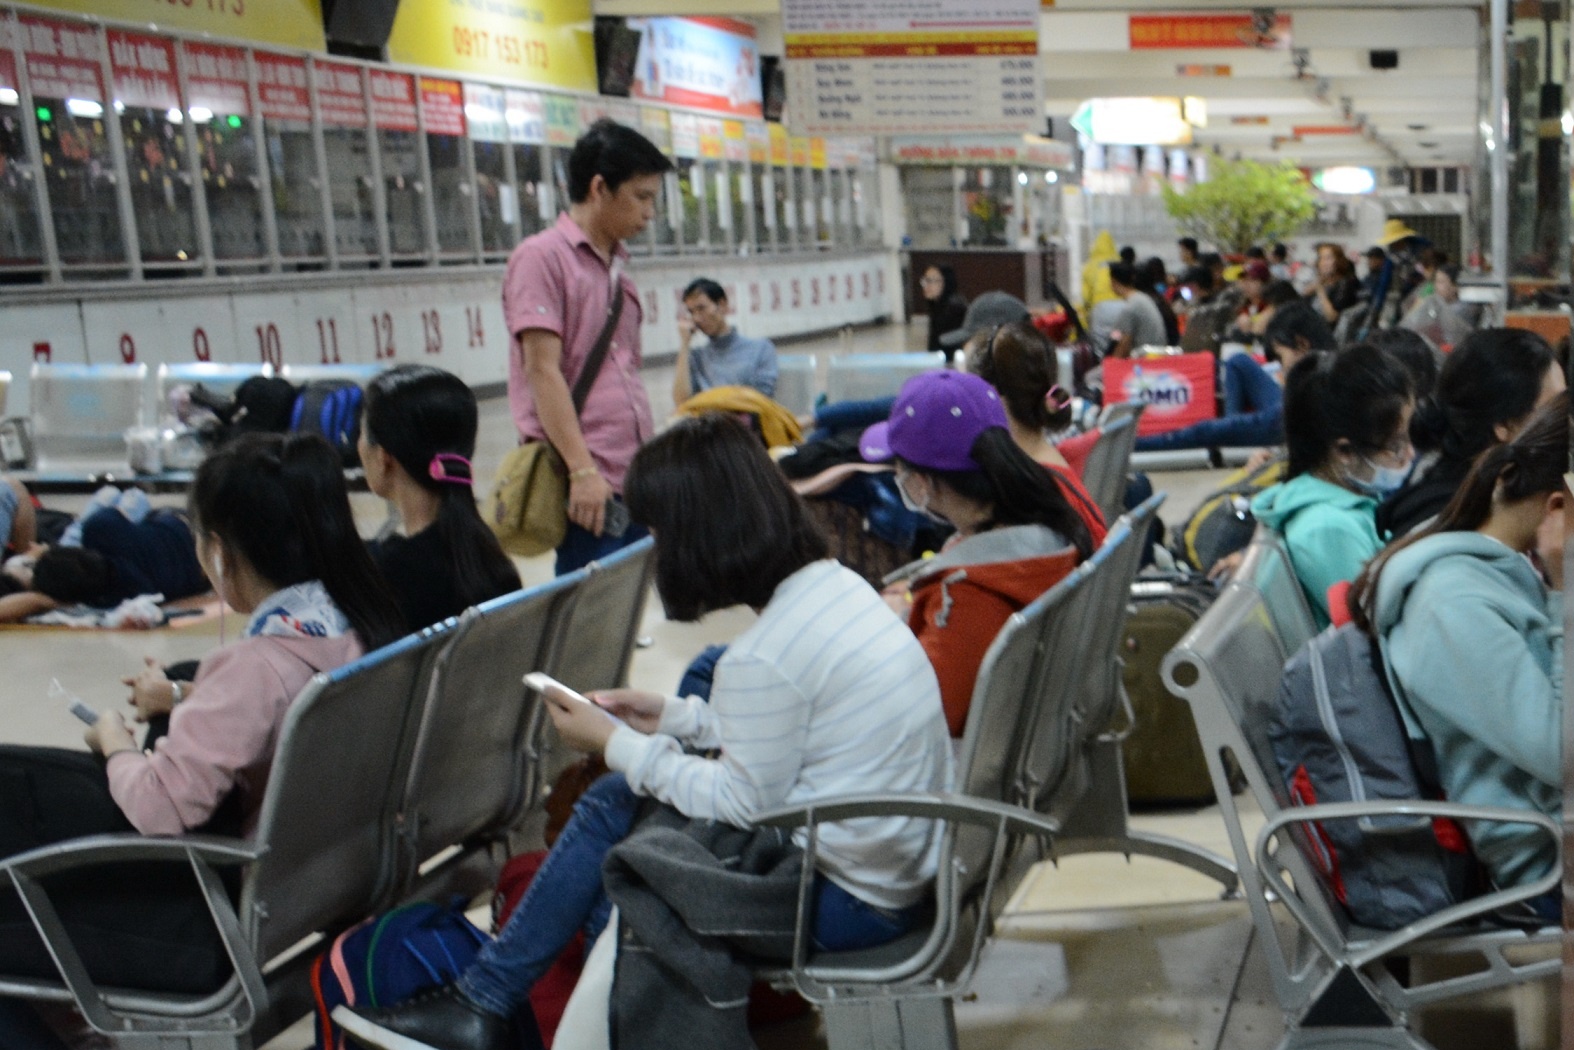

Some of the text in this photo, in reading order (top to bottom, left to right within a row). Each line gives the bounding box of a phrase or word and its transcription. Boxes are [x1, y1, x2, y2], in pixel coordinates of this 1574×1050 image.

[256, 321, 282, 373] 10
[316, 317, 339, 364] 11
[371, 311, 395, 359] 12
[421, 308, 443, 354] 13
[465, 304, 485, 348] 14
